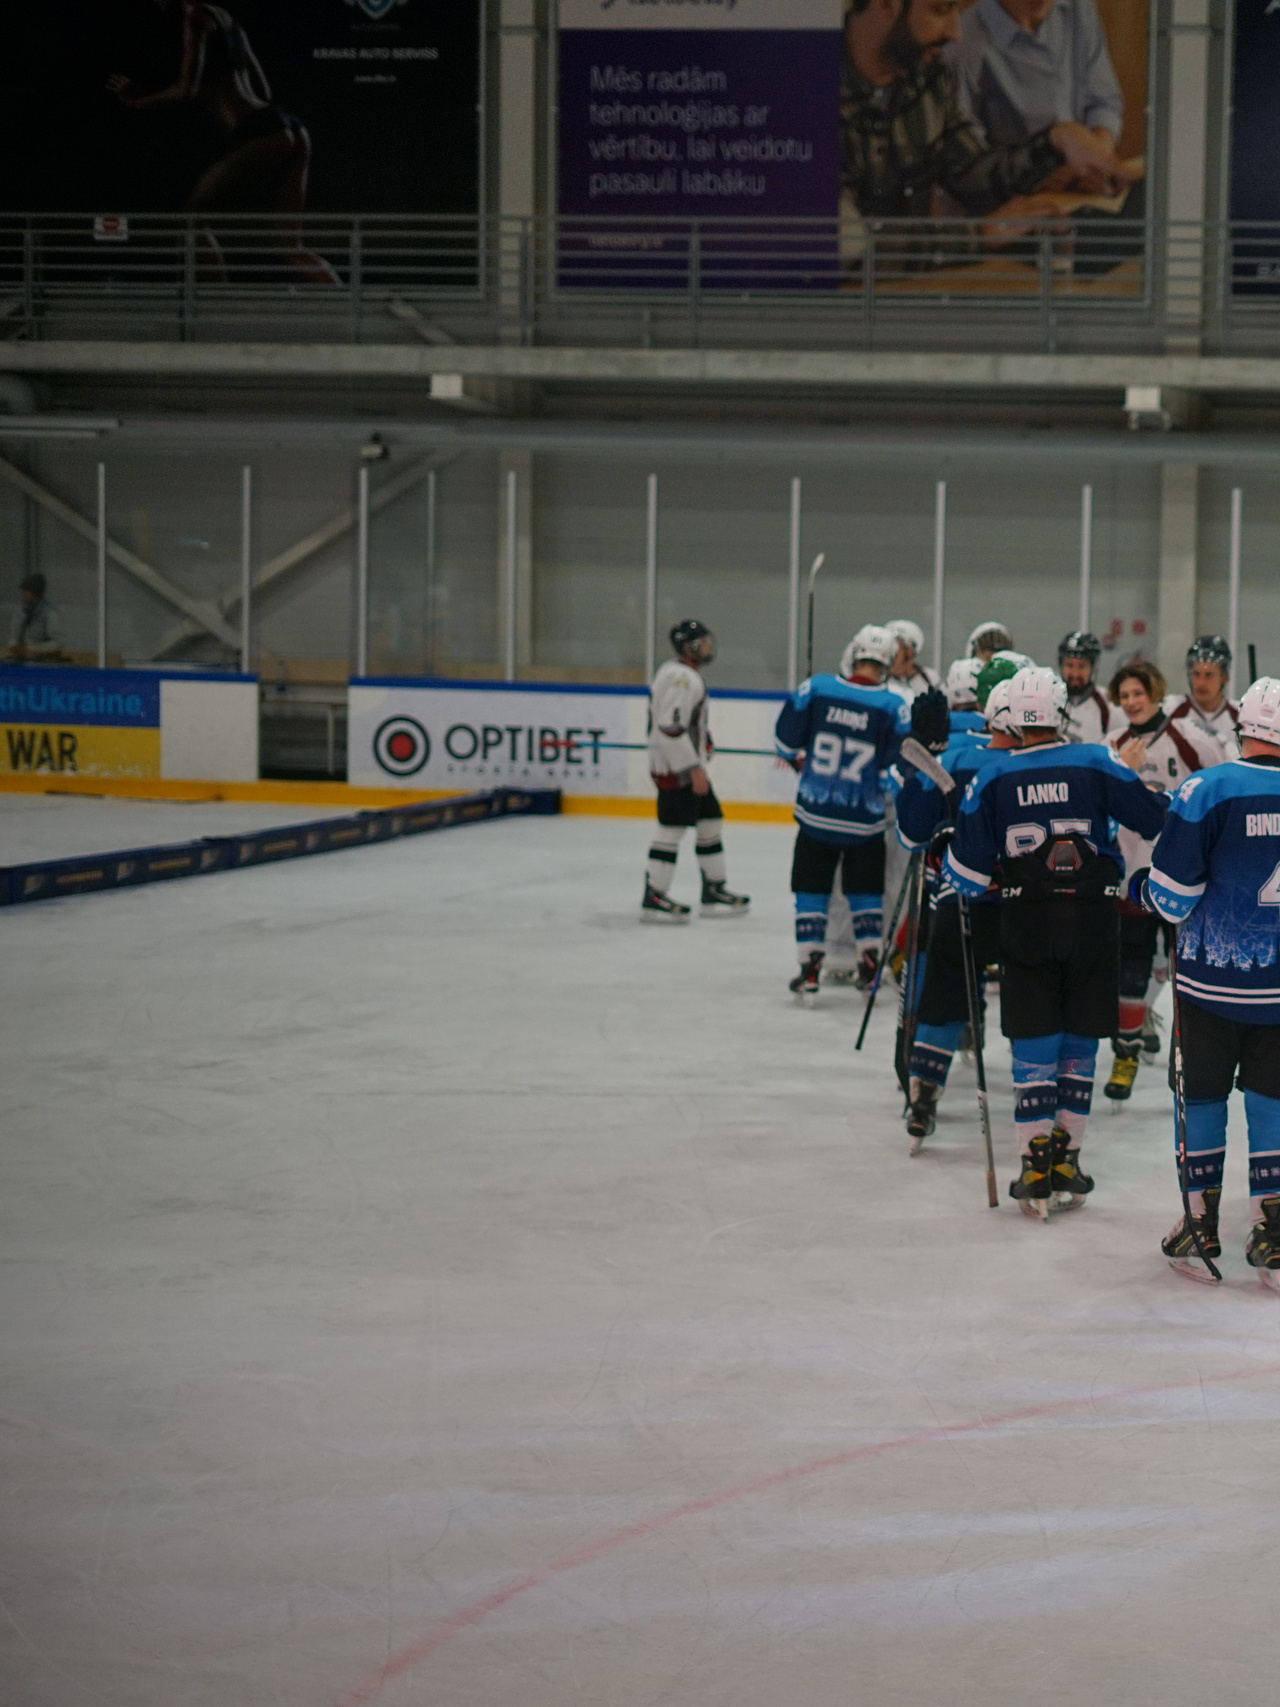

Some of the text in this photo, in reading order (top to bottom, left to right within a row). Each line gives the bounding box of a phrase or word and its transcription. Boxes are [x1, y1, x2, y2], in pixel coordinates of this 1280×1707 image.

[590, 65, 728, 93] Mēs radām
[589, 101, 770, 133] tehnoloģijas ar
[686, 134, 716, 161] lai
[719, 134, 813, 162] veidotu
[589, 168, 766, 199] pasauli labāku
[1023, 711, 1038, 723] 85
[6, 729, 79, 771] WAR
[445, 723, 605, 765] OPTIBET
[810, 730, 877, 783] 97
[1168, 757, 1178, 778] C
[1016, 781, 1069, 807] LANKO
